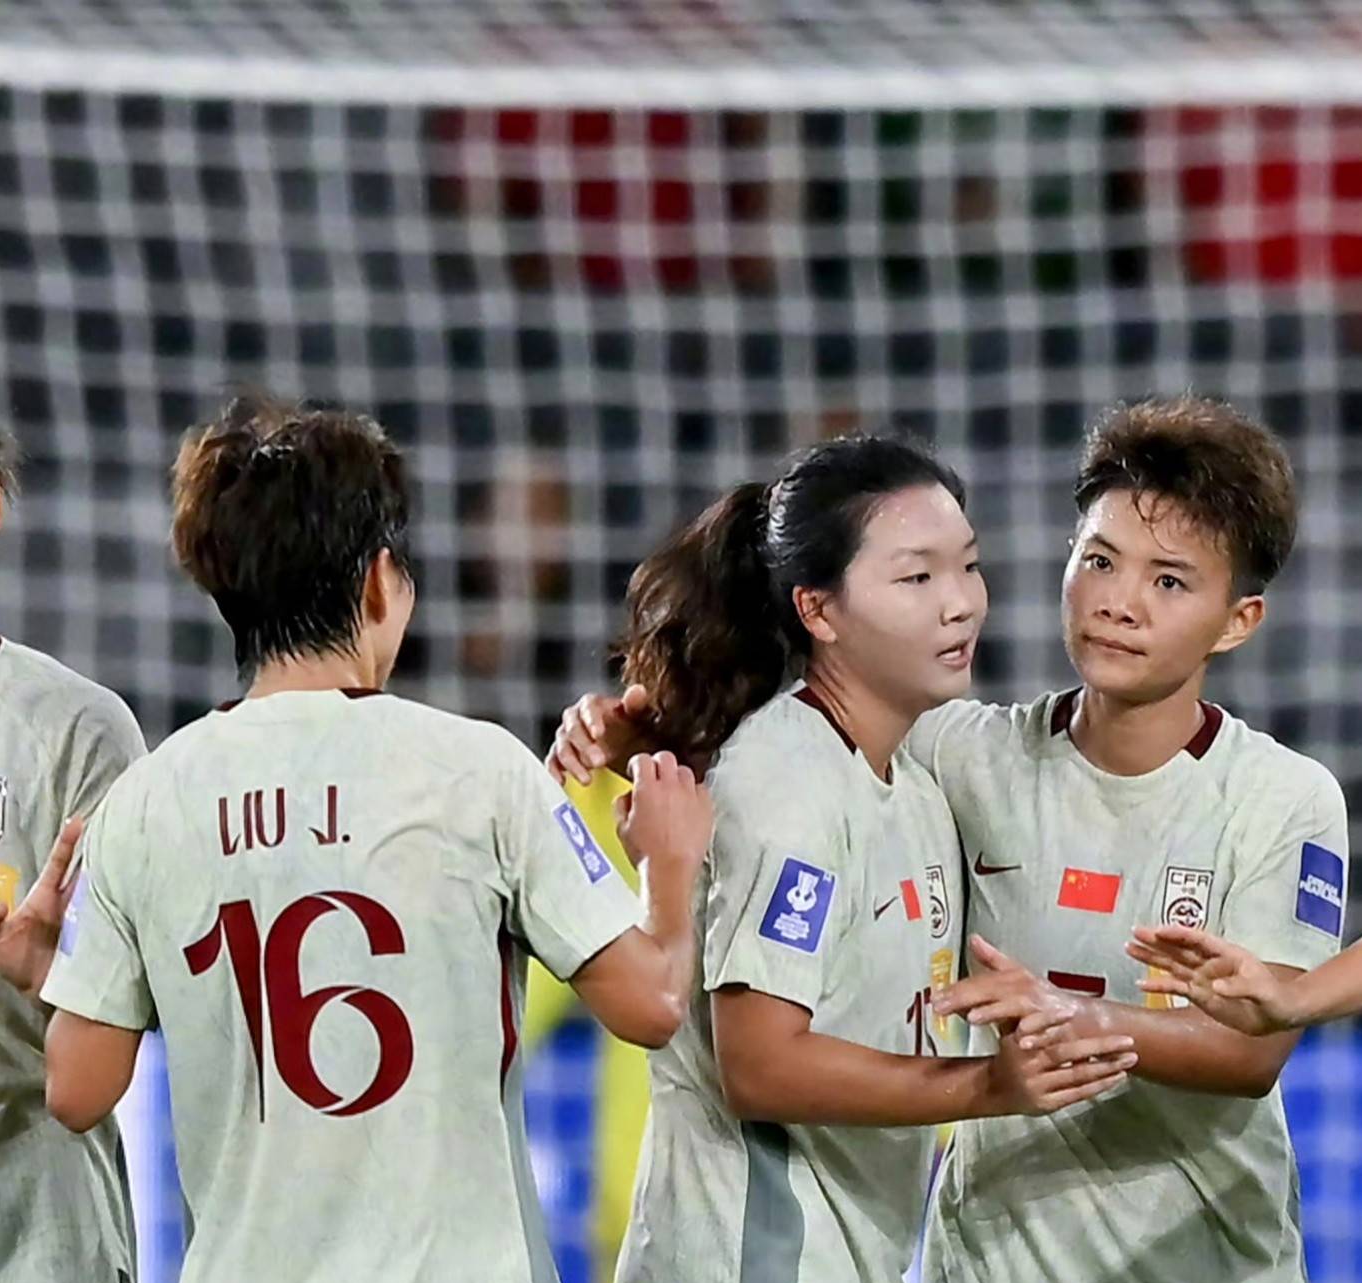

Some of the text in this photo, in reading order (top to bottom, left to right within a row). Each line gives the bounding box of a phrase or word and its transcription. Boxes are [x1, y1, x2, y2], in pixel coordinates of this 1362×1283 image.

[219, 785, 351, 856] LIU J.
[182, 890, 414, 1123] 16
